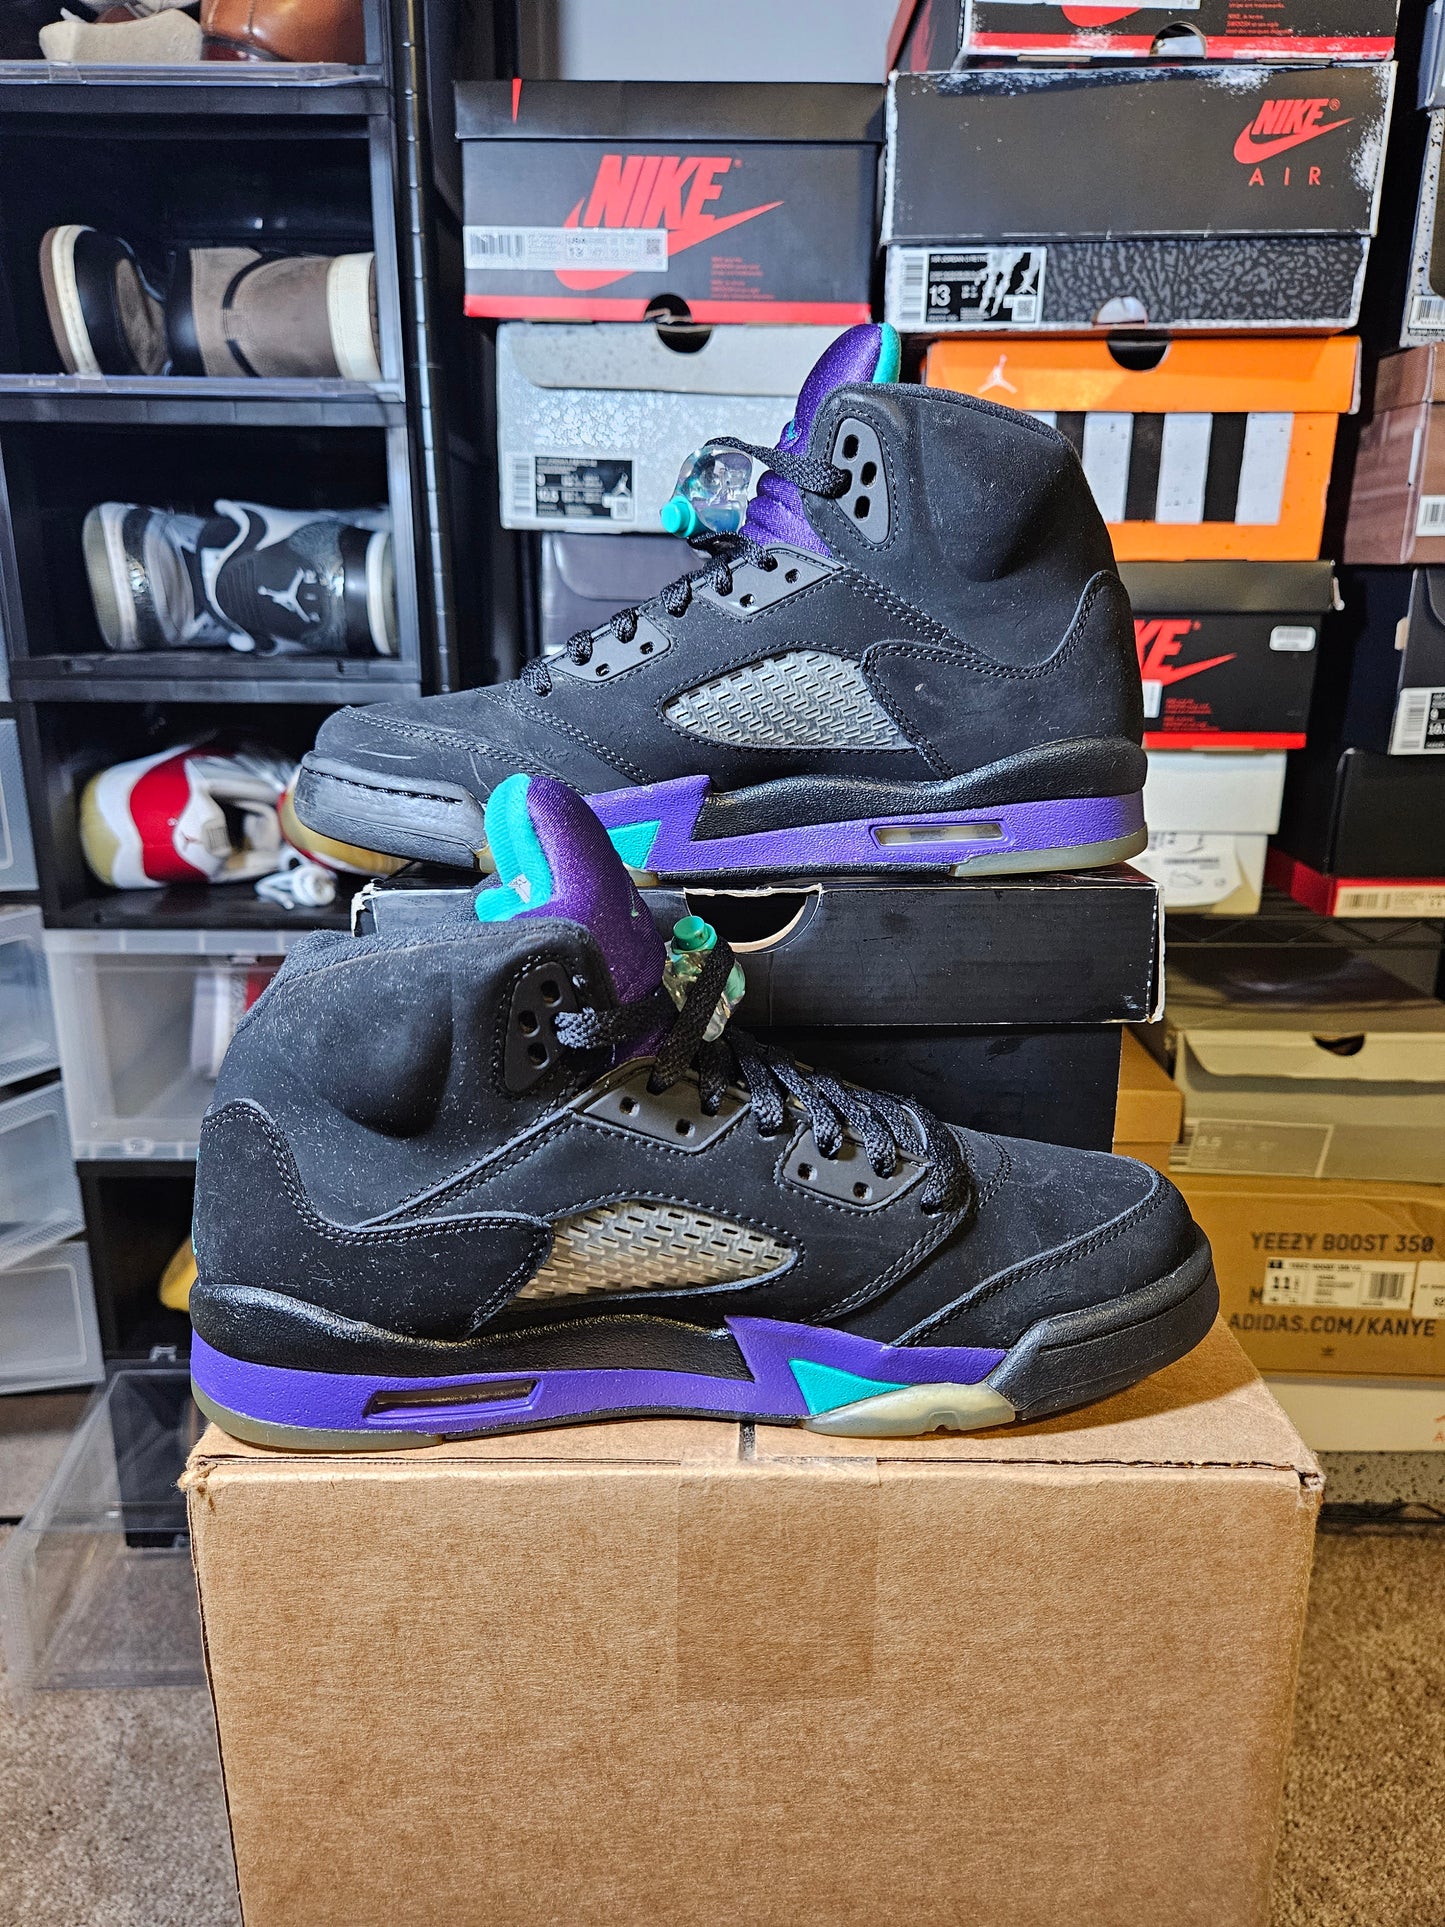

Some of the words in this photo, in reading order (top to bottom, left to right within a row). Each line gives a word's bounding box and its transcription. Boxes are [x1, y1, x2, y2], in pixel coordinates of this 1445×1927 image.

[1251, 98, 1329, 136] NIKE
[1248, 166, 1321, 187] AIR
[583, 154, 732, 231] NIKE
[928, 283, 951, 307] 13
[1133, 618, 1192, 675] KE
[1251, 1232, 1317, 1250] YEEZY
[1322, 1233, 1388, 1251] BOOST
[1394, 1235, 1434, 1253] 350
[1229, 1312, 1437, 1337] ADIDAS.COM/KANYE
